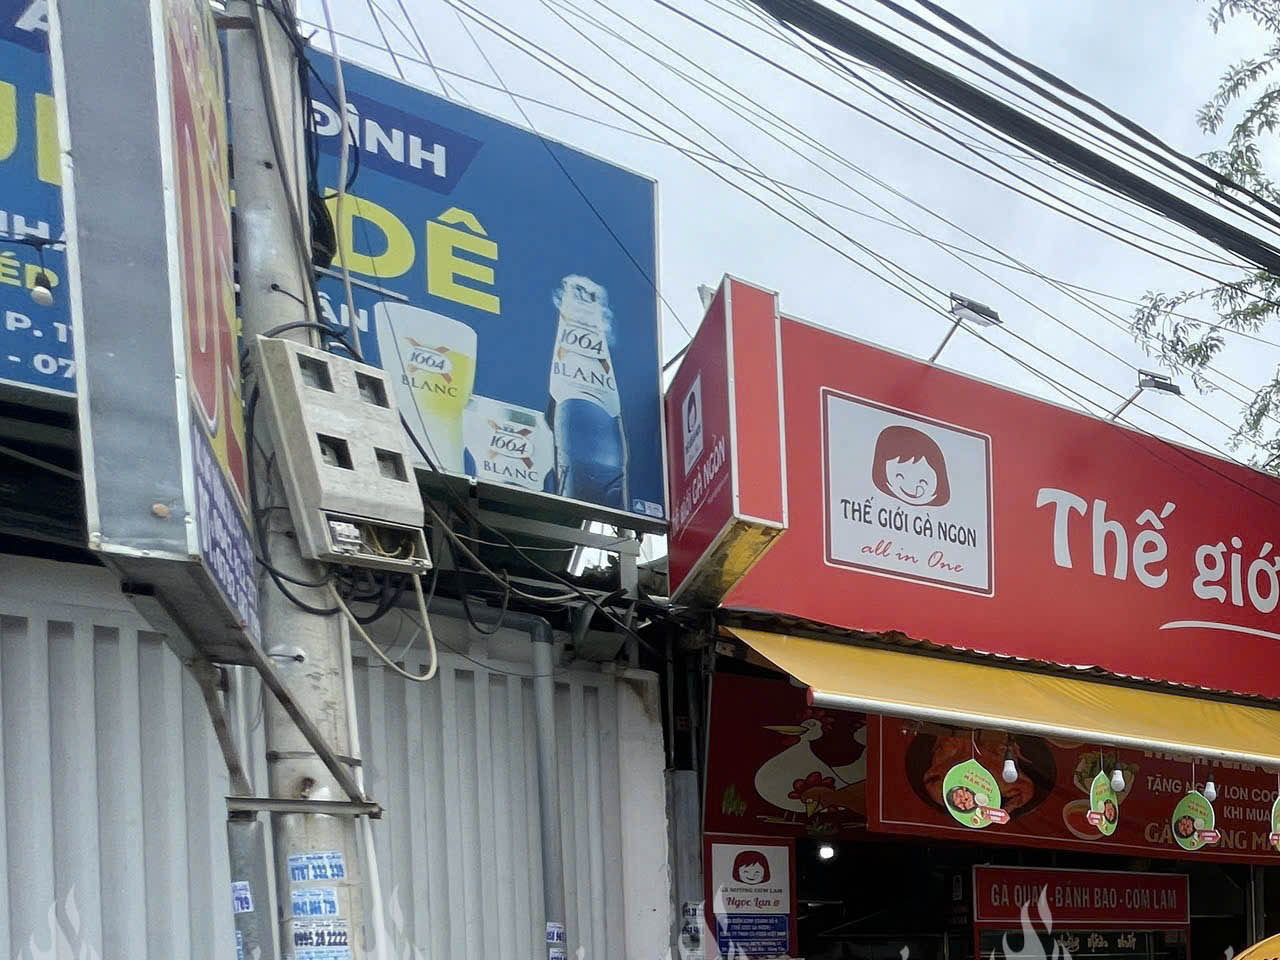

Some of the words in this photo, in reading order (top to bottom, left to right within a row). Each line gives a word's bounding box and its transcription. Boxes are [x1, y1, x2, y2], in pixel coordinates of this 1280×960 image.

[323, 187, 500, 315] DÊ
[560, 326, 604, 355] 1664
[409, 350, 446, 372] 1664
[401, 373, 458, 399] BLANC
[488, 433, 528, 456] 1664
[482, 458, 538, 483] BLANC
[841, 497, 874, 525] THẾ
[878, 506, 909, 533] GIỚI
[913, 512, 933, 538] GÀ
[938, 521, 977, 547] NGON
[1036, 487, 1177, 589] Thế
[861, 540, 893, 558] all
[895, 547, 919, 564] in
[928, 550, 964, 573] One
[1224, 786, 1249, 802] LON
[1223, 805, 1246, 820] KHI
[1249, 808, 1271, 822] MUA
[991, 880, 1010, 908] GÀ
[1055, 882, 1091, 909] BÁNH
[1094, 888, 1118, 910] BAO
[1153, 889, 1177, 910] LAM
